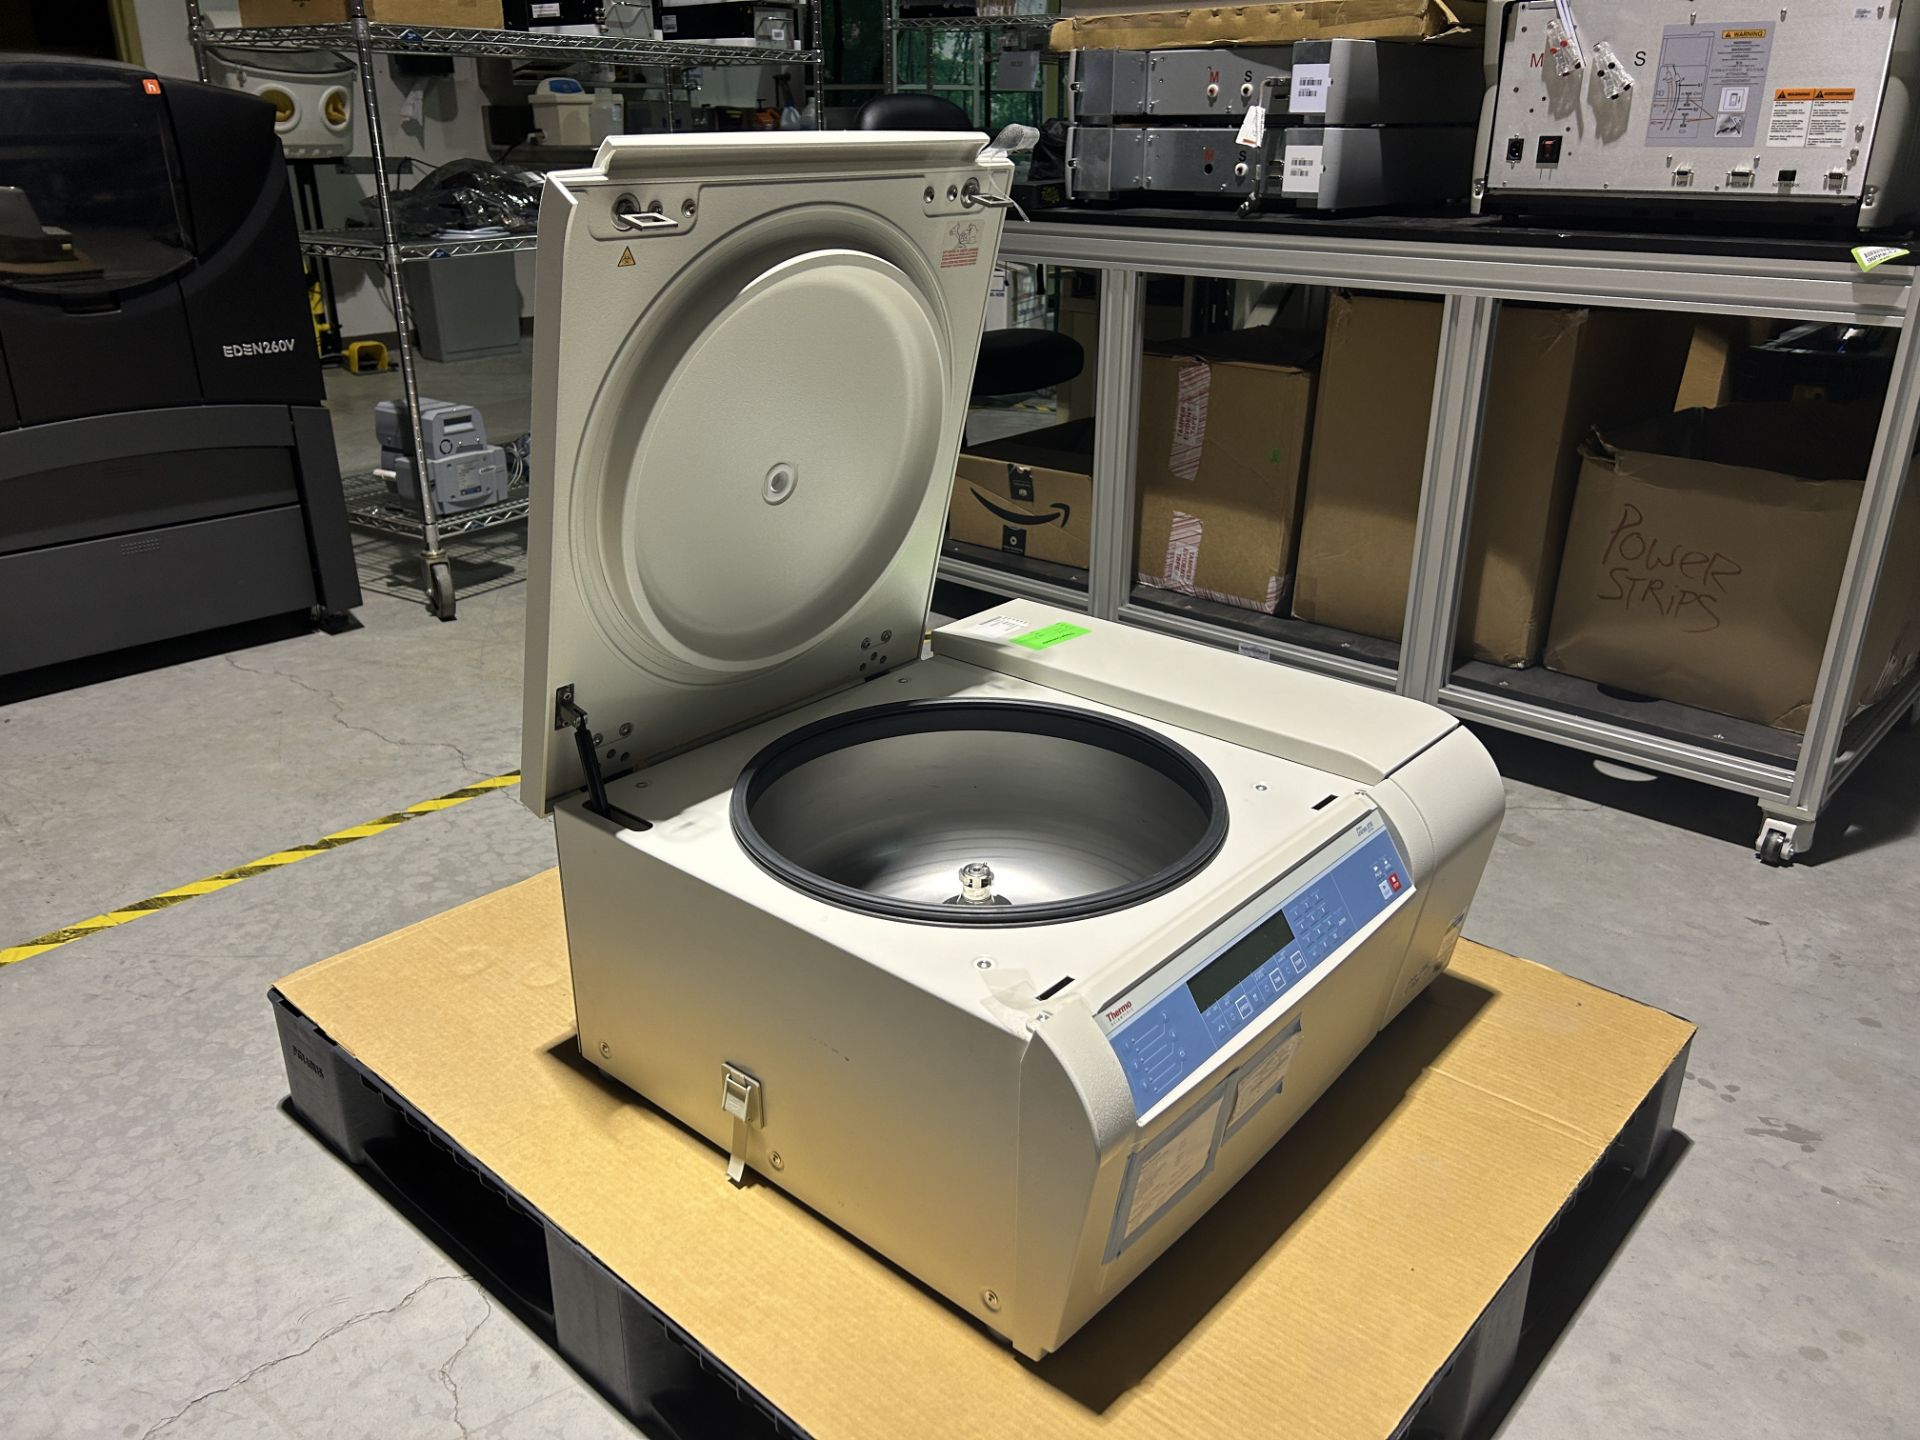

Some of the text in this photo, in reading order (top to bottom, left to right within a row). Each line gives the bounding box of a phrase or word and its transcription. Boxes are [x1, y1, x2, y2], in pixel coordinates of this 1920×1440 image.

[1733, 30, 1763, 38] WARNING
[1530, 53, 1545, 68] M
[1634, 51, 1647, 67] S
[1209, 71, 1220, 83] M
[1244, 70, 1253, 82] S
[1238, 150, 1247, 162] S
[222, 338, 296, 358] EDEN260V
[1106, 1001, 1133, 1022] Thermo
